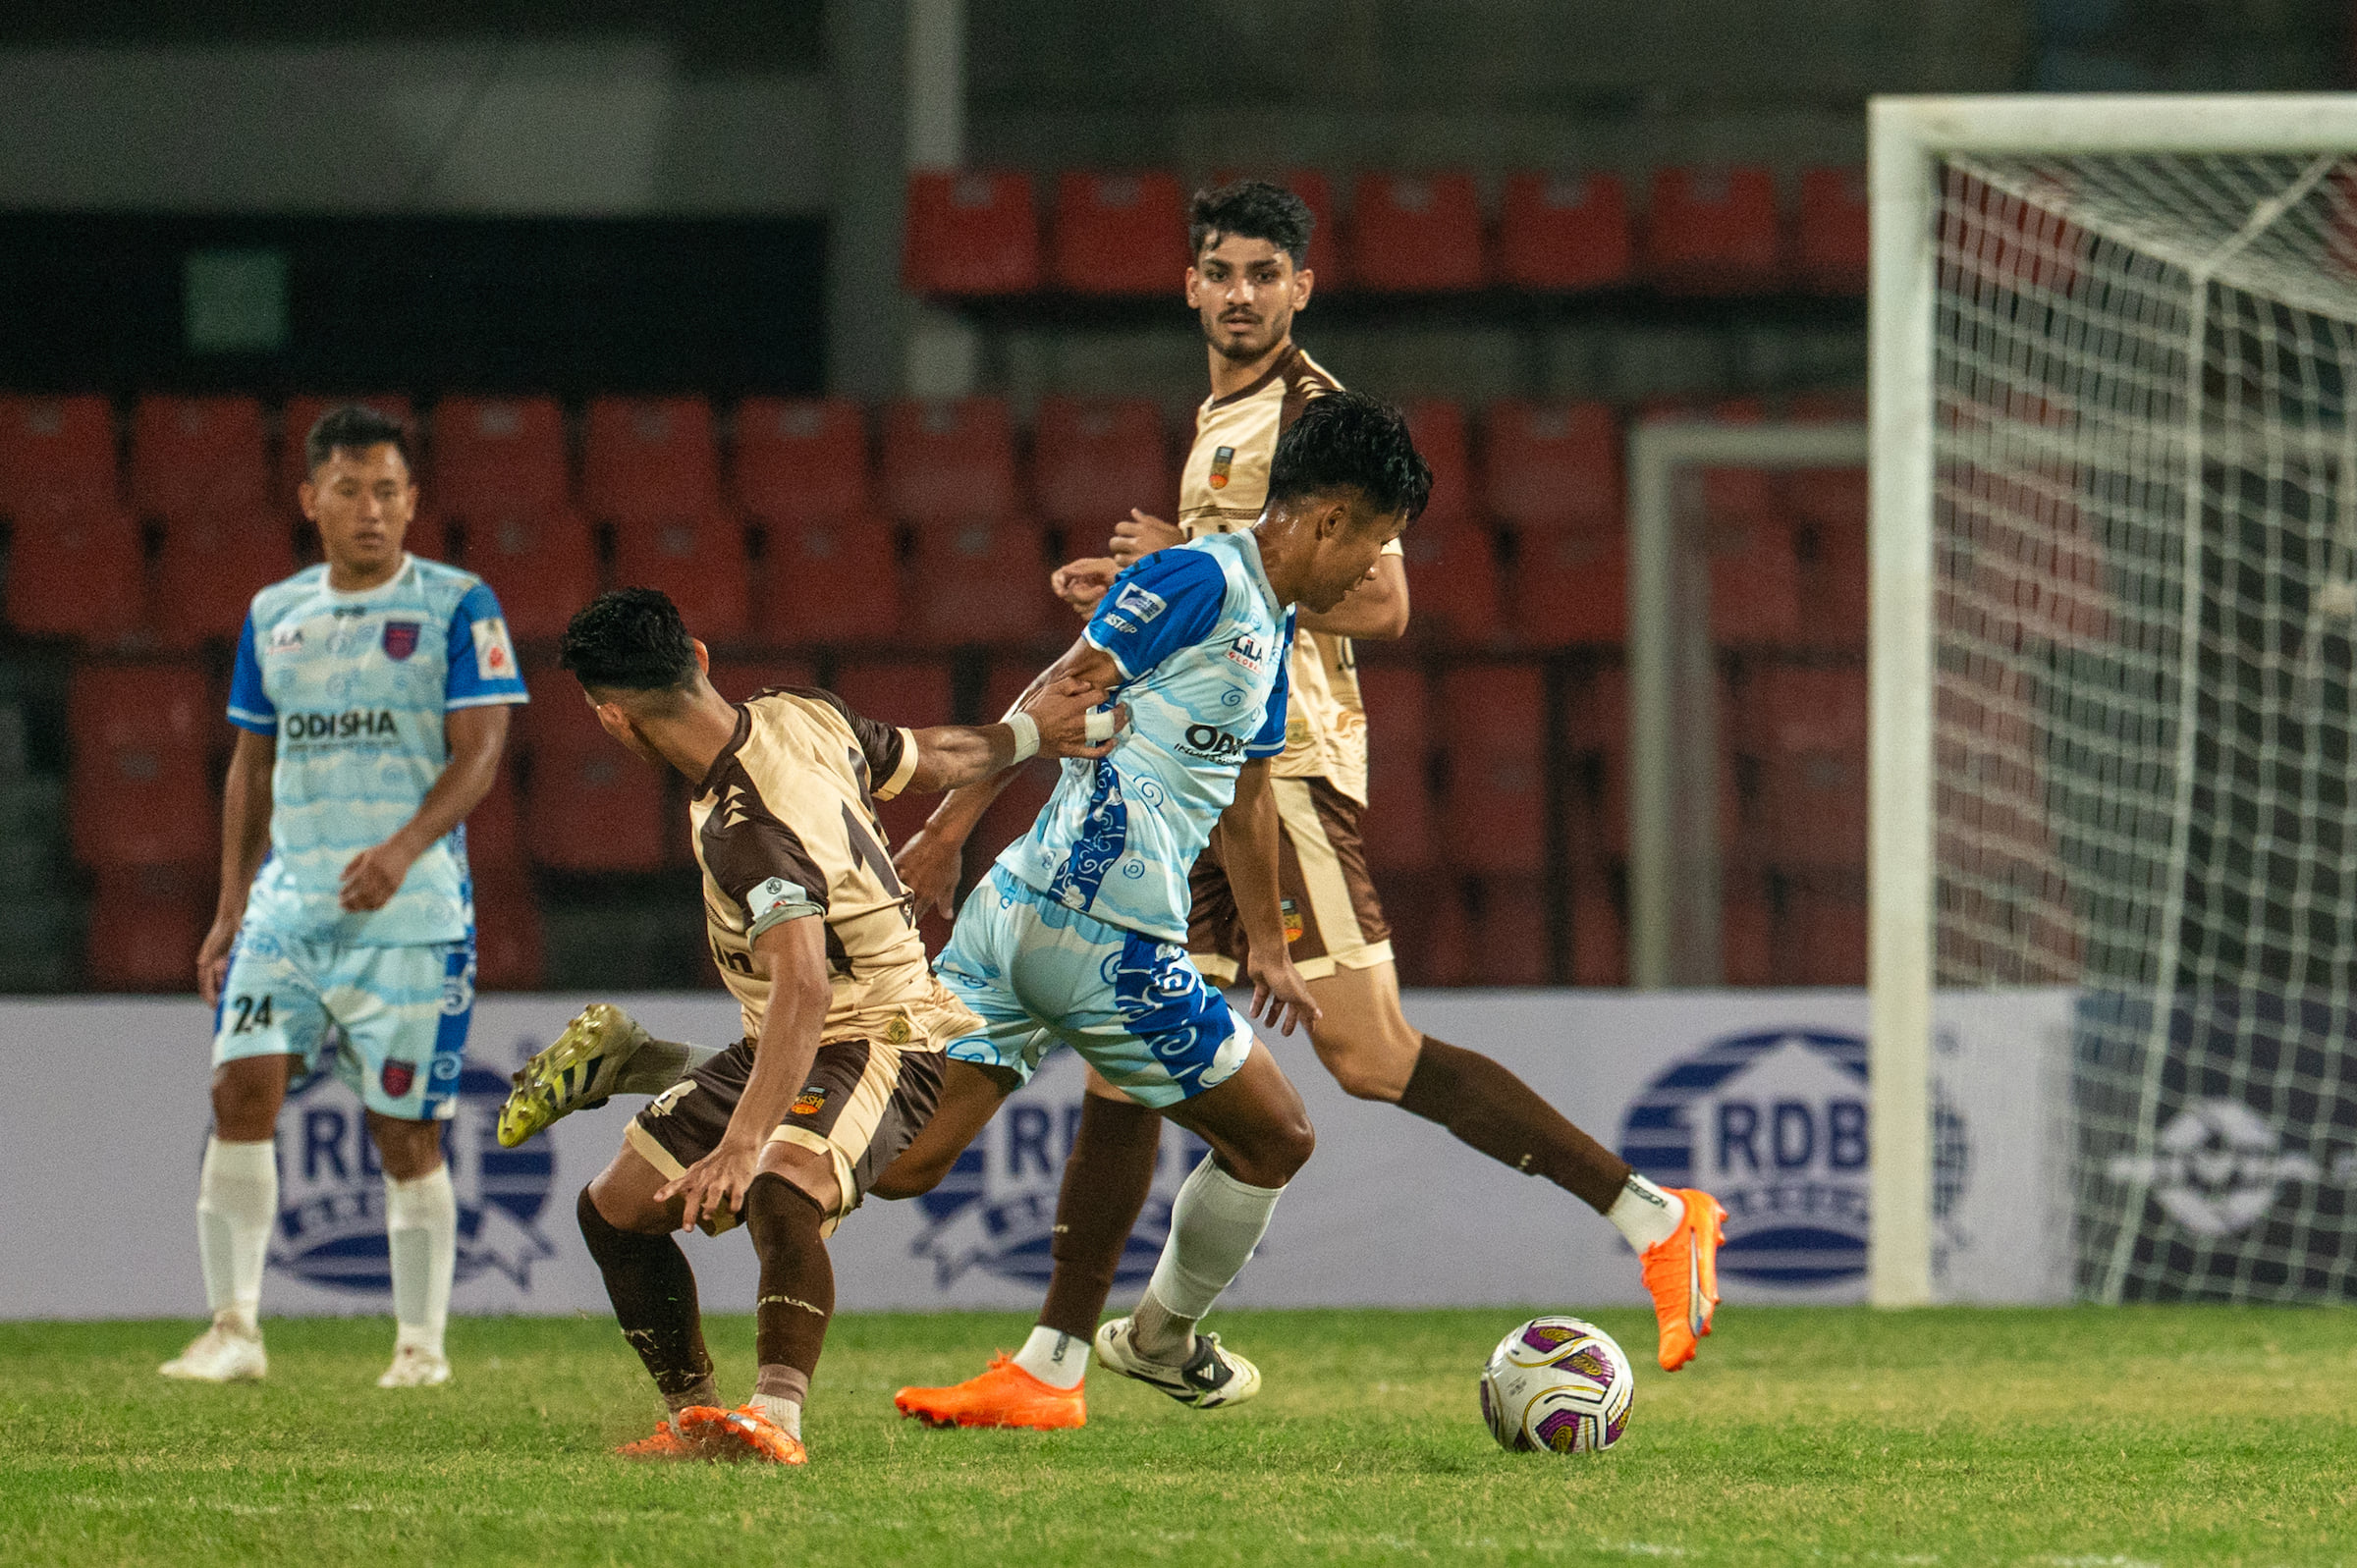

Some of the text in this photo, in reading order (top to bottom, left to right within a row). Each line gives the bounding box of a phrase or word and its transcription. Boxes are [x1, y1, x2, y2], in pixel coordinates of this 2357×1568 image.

[287, 709, 400, 739] ODISHA
[233, 993, 273, 1036] 24
[1718, 1100, 1870, 1169] RDB
